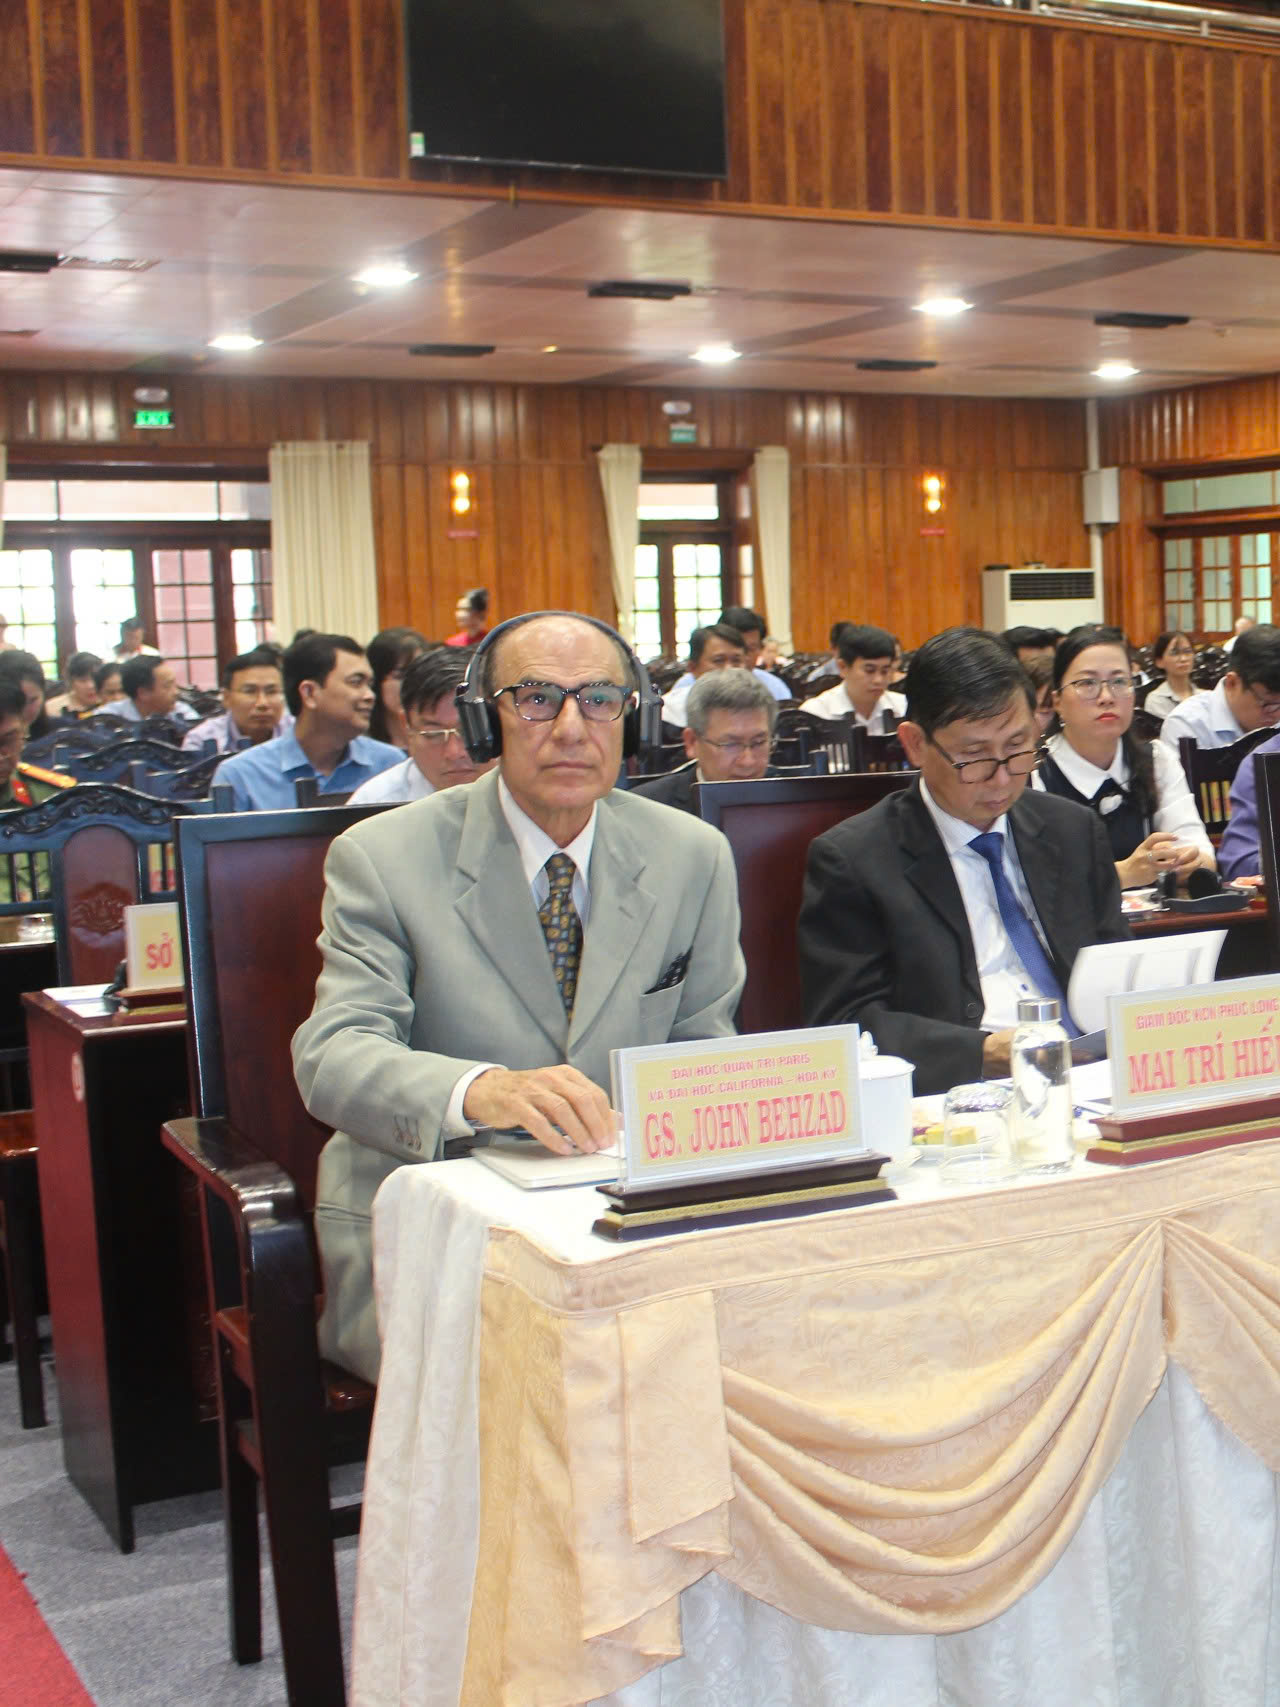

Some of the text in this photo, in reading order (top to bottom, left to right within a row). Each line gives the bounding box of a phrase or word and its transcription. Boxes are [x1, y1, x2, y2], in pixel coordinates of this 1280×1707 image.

[778, 1052, 812, 1067] PARIS
[1127, 1049, 1177, 1094] MAI
[1184, 1031, 1226, 1086] TRÍ
[719, 1075, 785, 1093] CALIFORNIA
[644, 1089, 848, 1160] GS. JOHN BEHZAD
